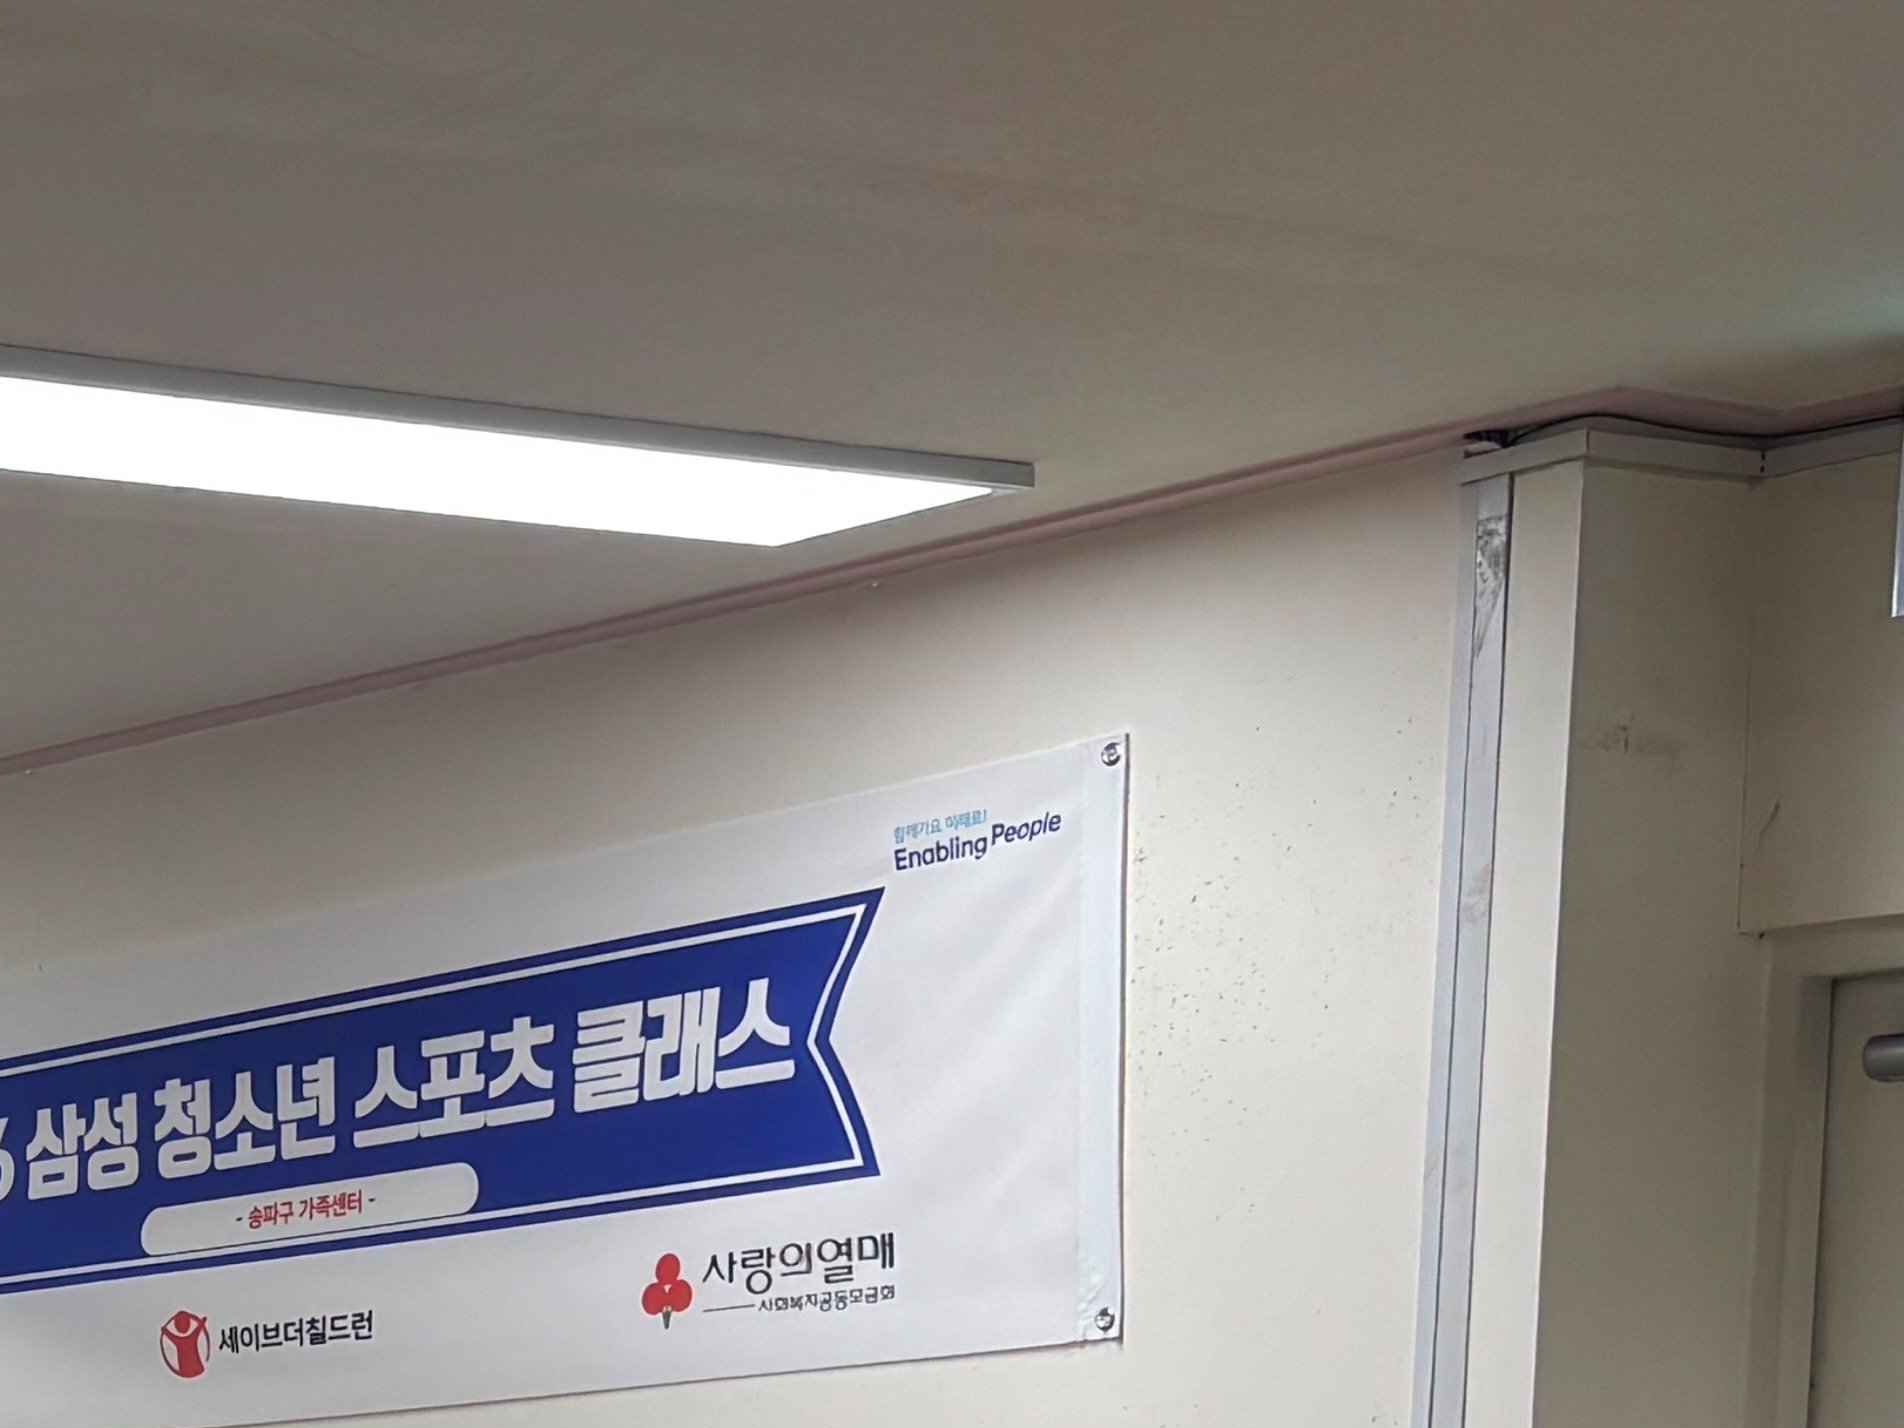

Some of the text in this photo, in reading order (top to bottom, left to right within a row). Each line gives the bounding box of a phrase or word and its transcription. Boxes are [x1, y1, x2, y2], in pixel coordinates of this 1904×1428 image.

[894, 811, 1062, 871] Enabling People
[25, 1092, 140, 1201] 삼성
[153, 1055, 337, 1180] 청소년
[352, 1015, 556, 1149] 스포츠
[571, 976, 796, 1113] 클래스
[248, 1189, 362, 1229] 송파구 가족센터
[702, 1232, 895, 1295] 사랑의열매
[219, 1309, 374, 1354] 세이브더칠드런
